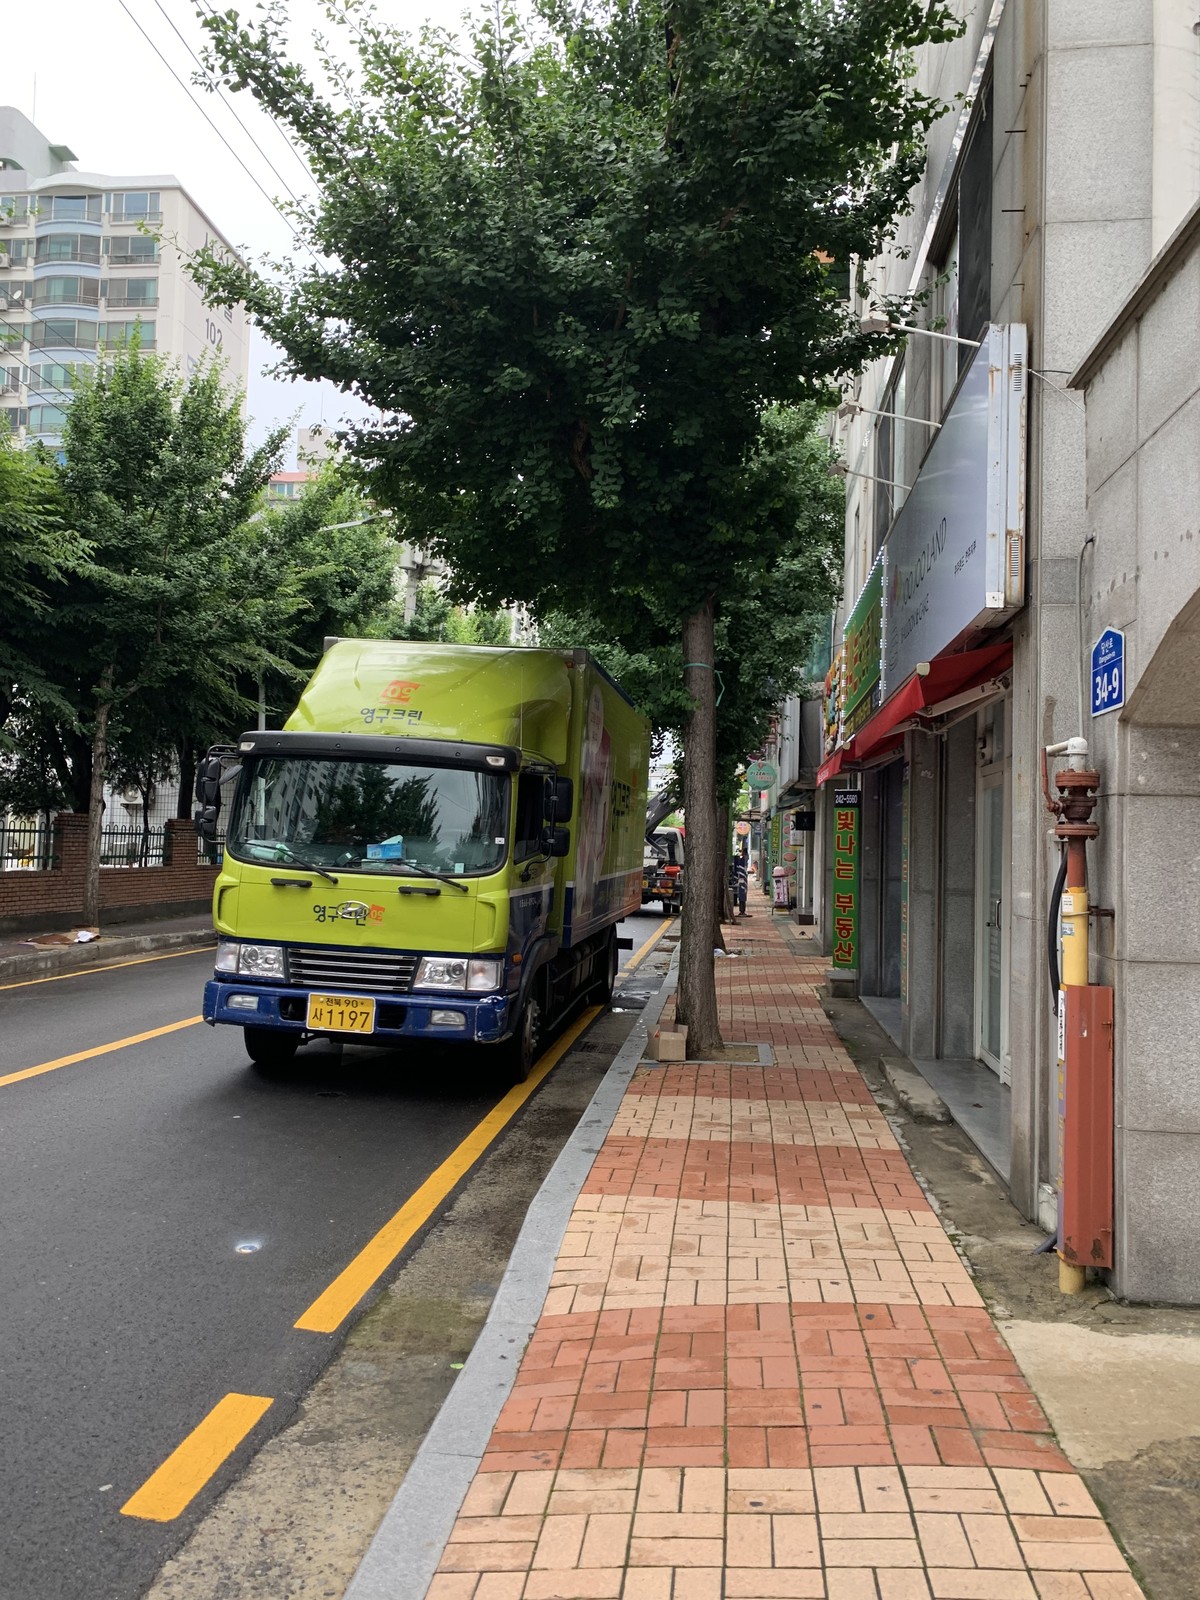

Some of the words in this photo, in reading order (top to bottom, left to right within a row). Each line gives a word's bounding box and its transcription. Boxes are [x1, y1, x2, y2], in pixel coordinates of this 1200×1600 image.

[1095, 667, 1119, 706] 34-9
[360, 707, 423, 726] 영구크린
[836, 810, 856, 880] 빛나는
[834, 893, 855, 963] 부동산
[325, 997, 341, 1007] 전북
[344, 998, 359, 1009] 90
